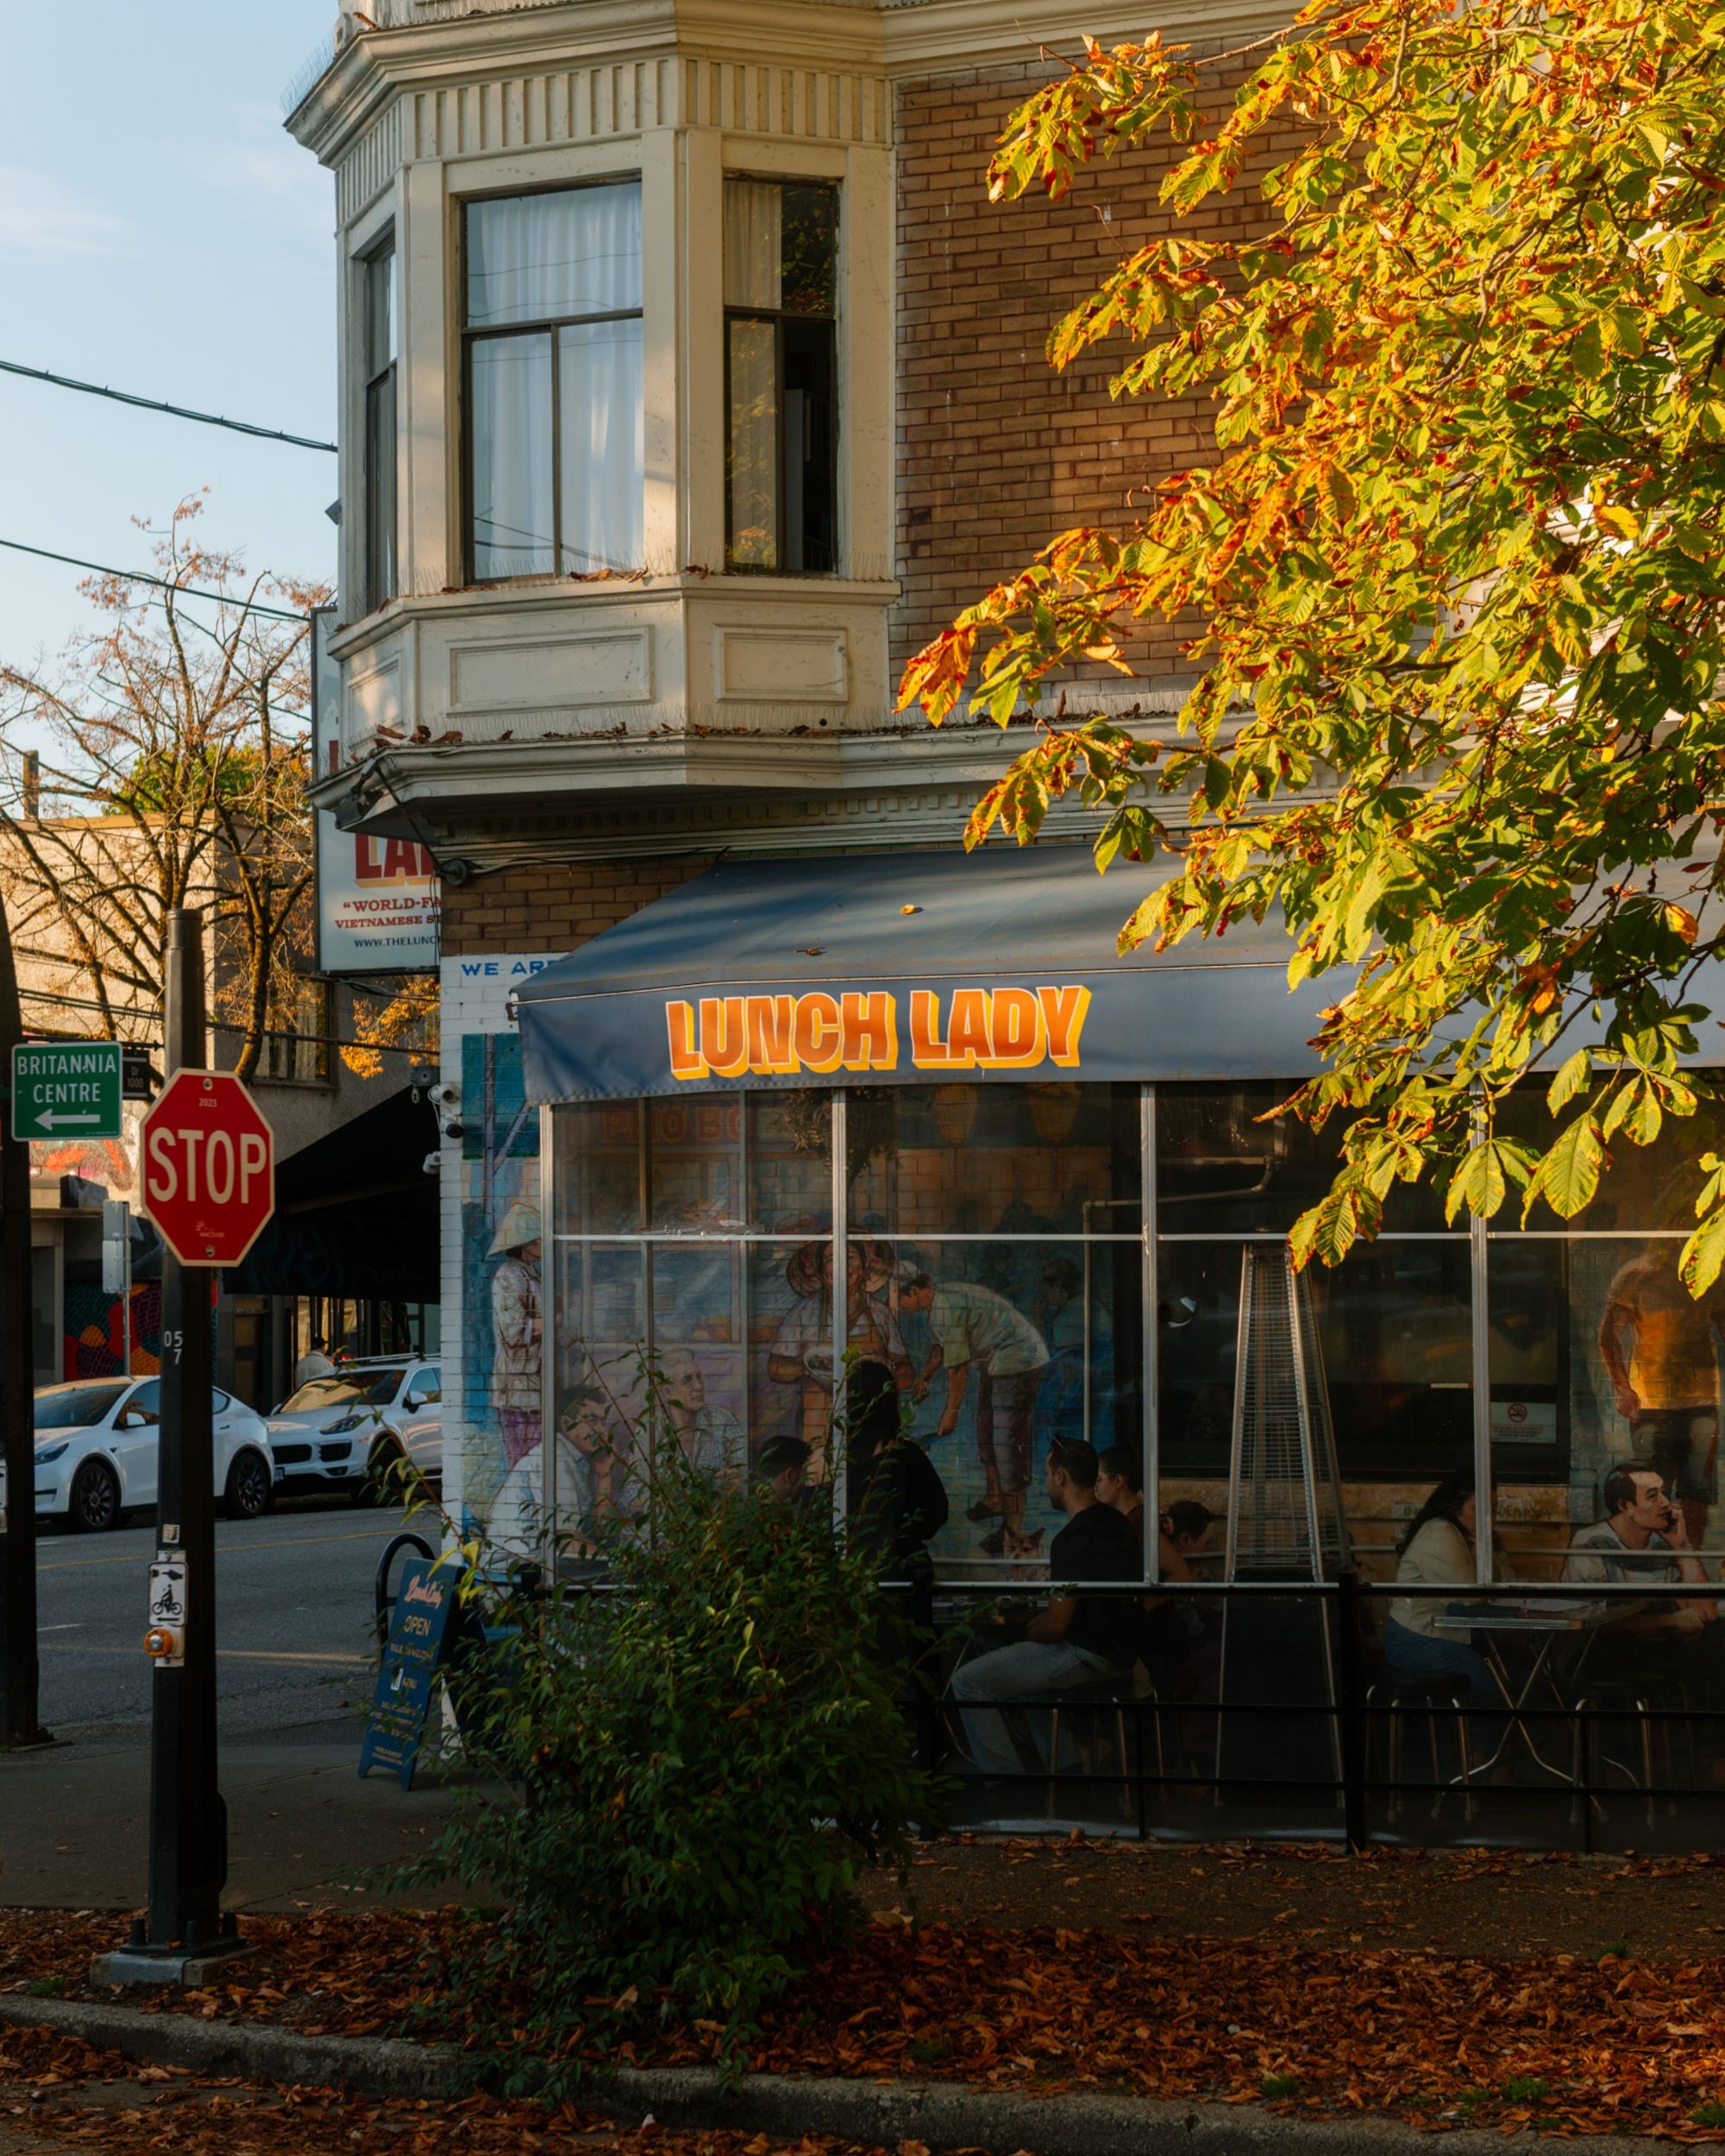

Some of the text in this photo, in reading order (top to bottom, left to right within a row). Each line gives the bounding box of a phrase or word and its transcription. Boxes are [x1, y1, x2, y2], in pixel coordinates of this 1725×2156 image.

[335, 915, 423, 929] VIETNAMESE
[461, 960, 557, 976] WE AR
[665, 984, 1092, 1080] LUNCH LADY
[17, 1053, 116, 1075] BRITANNIA
[33, 1082, 101, 1103] CENTRE
[198, 1098, 217, 1107] 2023
[147, 1127, 267, 1204] STOP
[164, 1330, 183, 1347] 05
[173, 1349, 182, 1365] 7
[404, 1614, 431, 1637] OPEN
